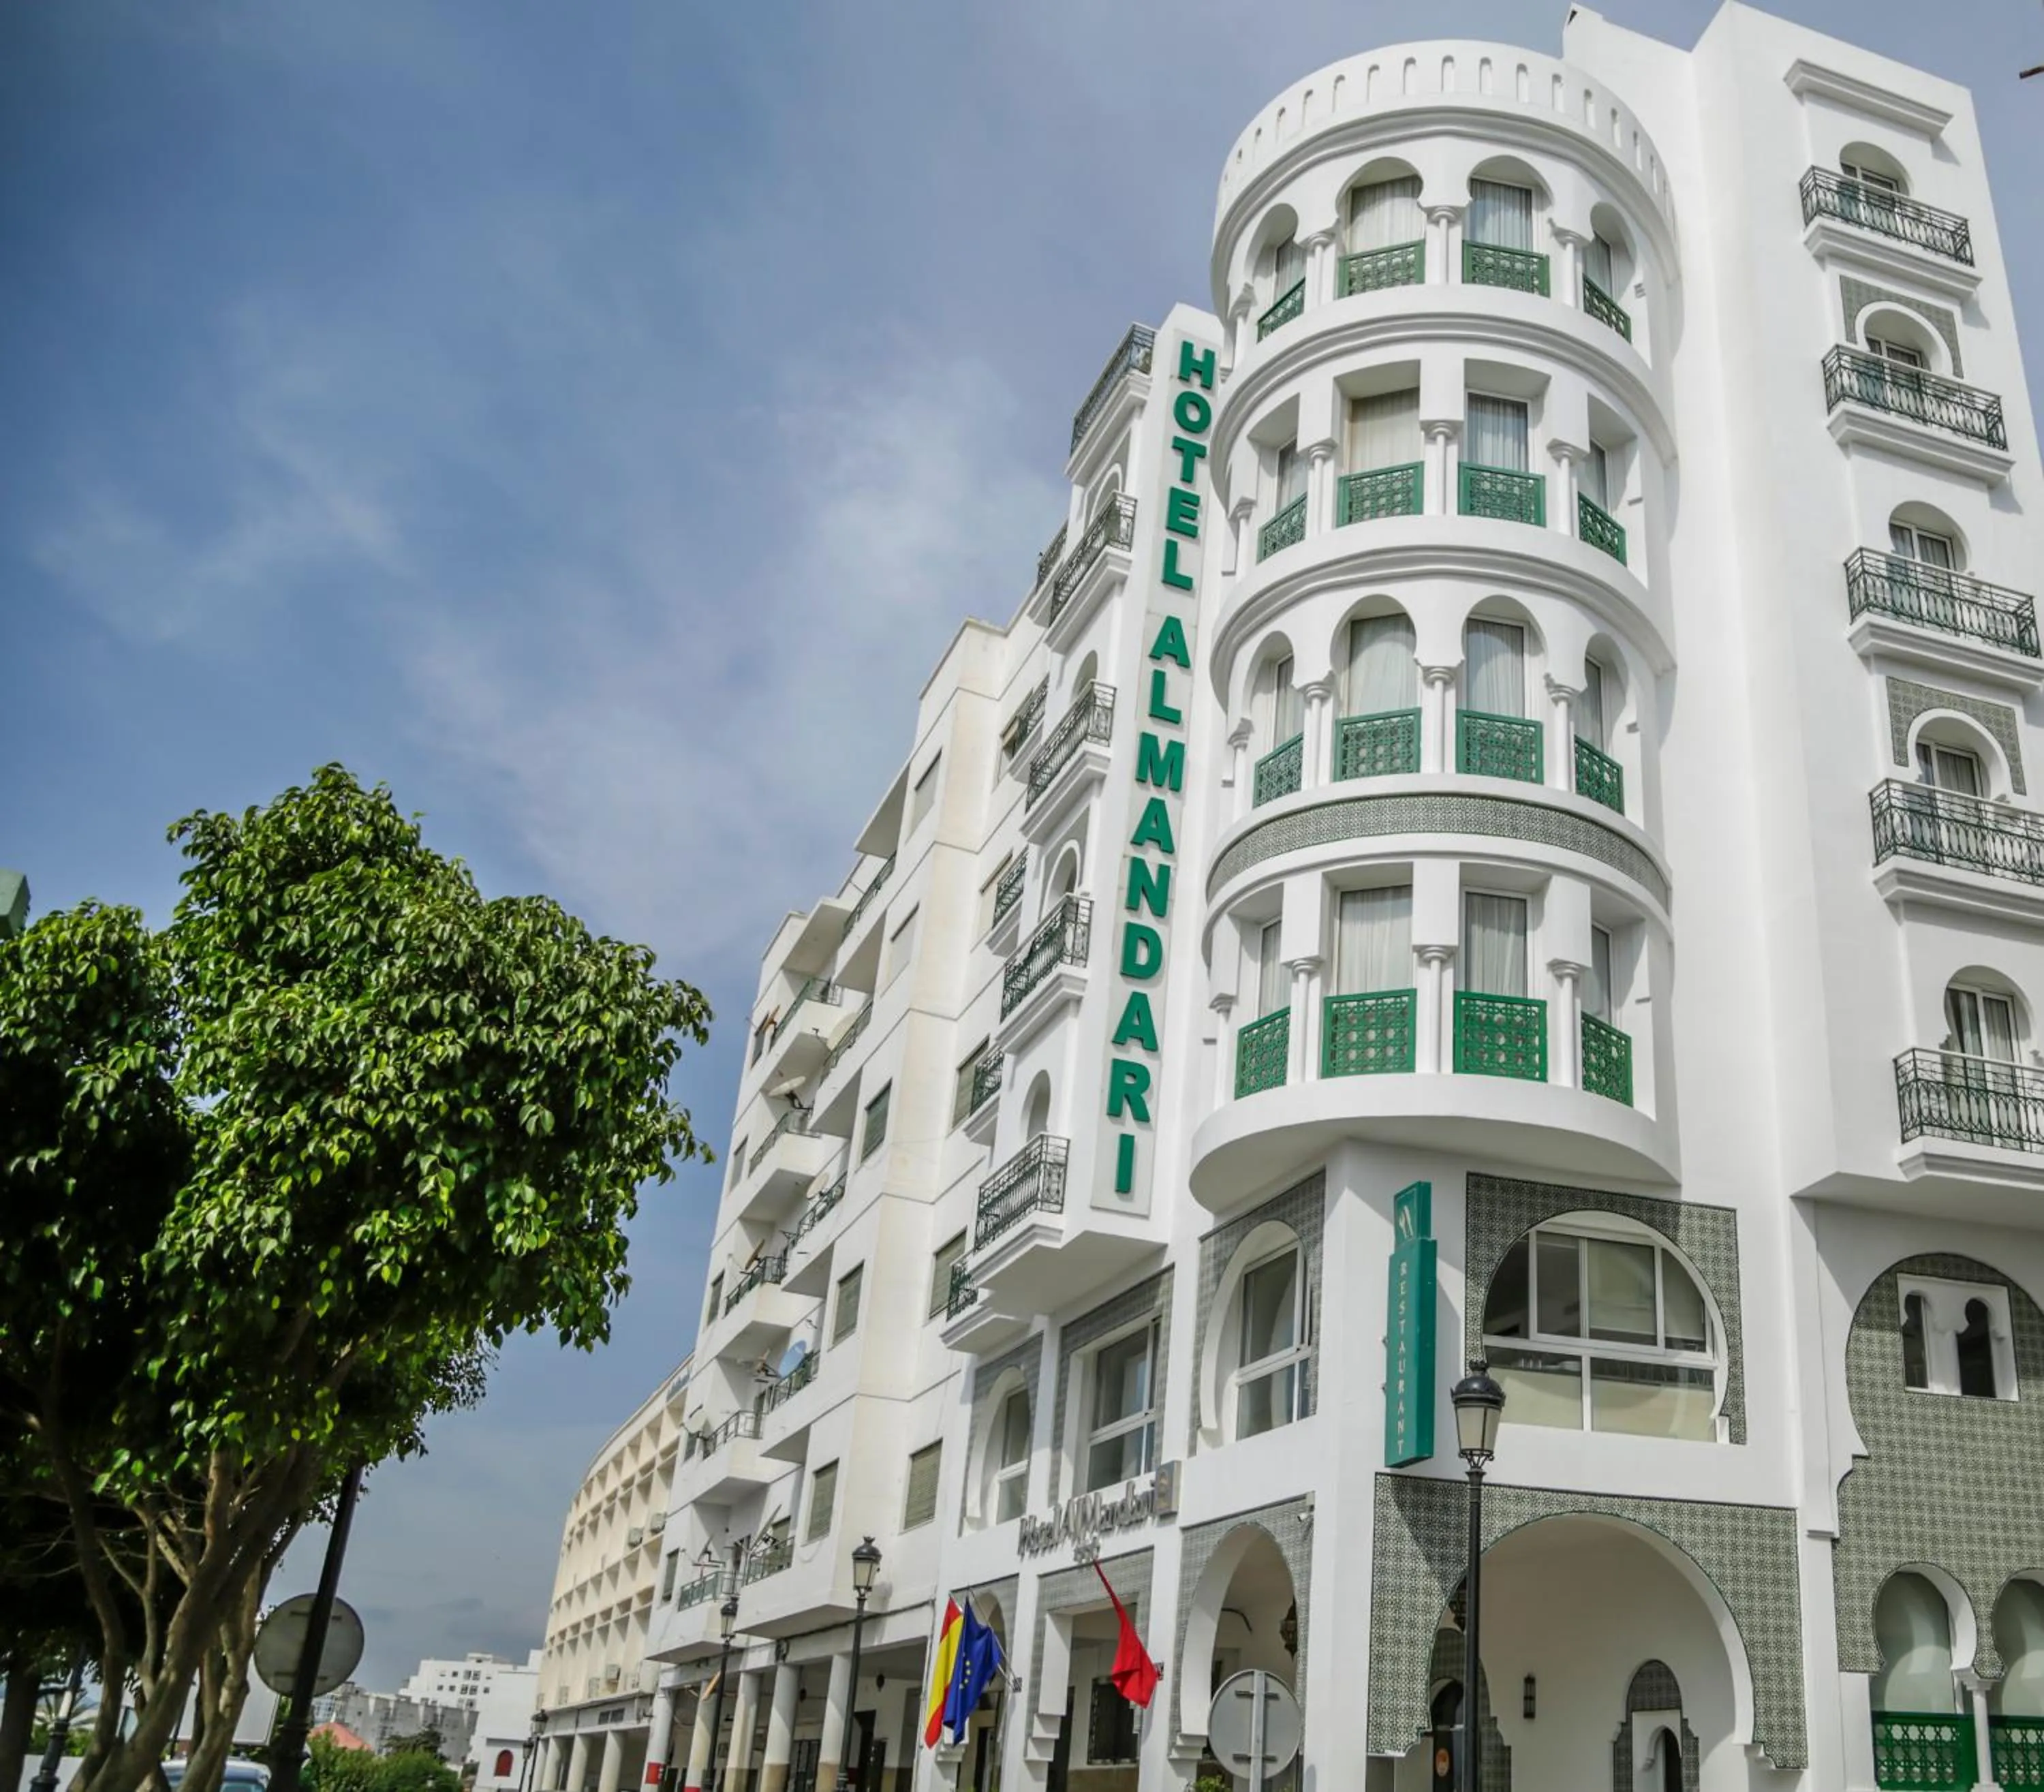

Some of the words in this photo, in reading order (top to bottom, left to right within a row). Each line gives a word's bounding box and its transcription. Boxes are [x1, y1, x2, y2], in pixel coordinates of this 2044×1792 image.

[1162, 341, 1216, 591] HOTEL
[1106, 615, 1191, 1194] ALMANDARI
[1397, 1261, 1408, 1457] RESTAURANT
